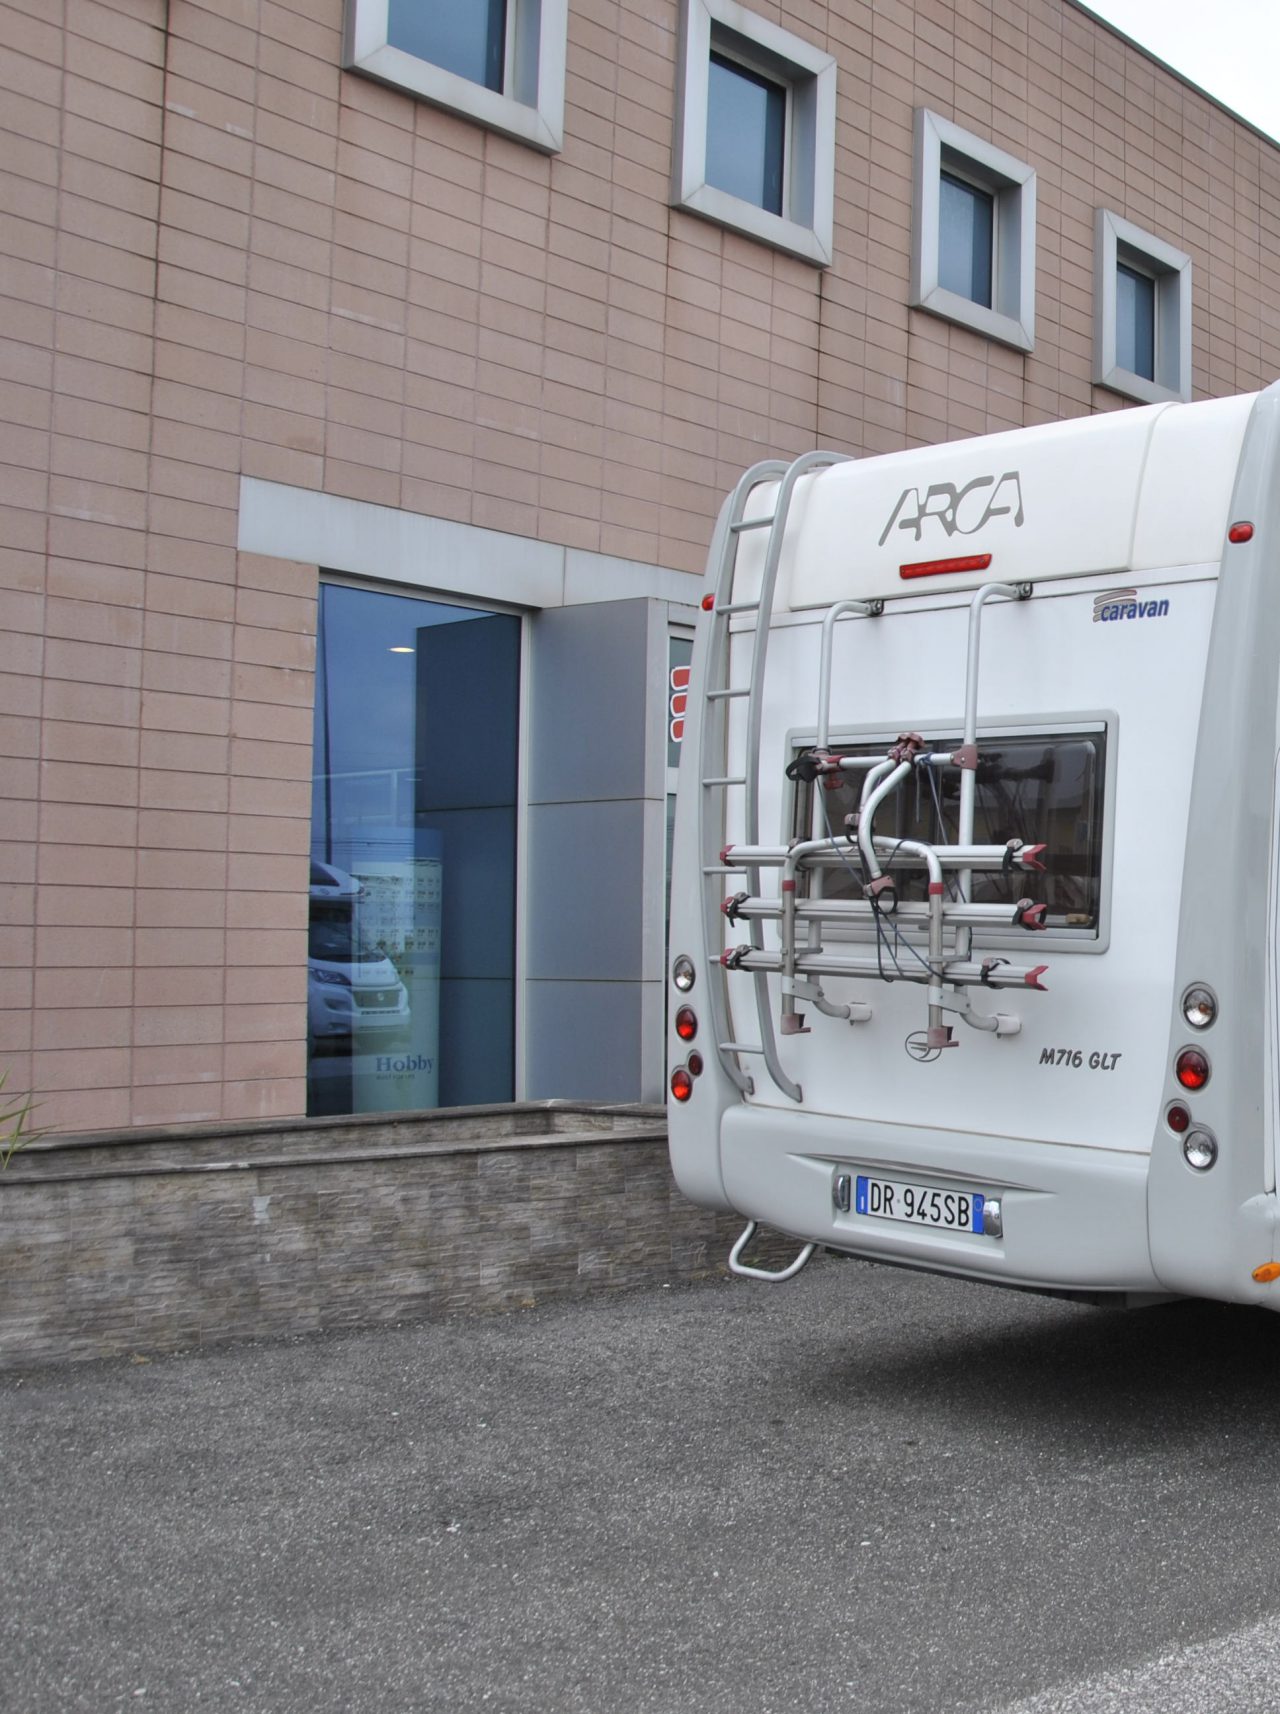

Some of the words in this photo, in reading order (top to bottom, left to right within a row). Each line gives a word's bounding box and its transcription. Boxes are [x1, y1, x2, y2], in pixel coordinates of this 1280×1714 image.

[878, 470, 1024, 547] ARCA
[1101, 599, 1169, 622] caravan
[376, 1055, 434, 1074] Hobby
[1039, 1048, 1083, 1069] M716
[1088, 1051, 1122, 1071] GLT
[870, 1182, 894, 1215] DR
[903, 1188, 970, 1227] 945SB
